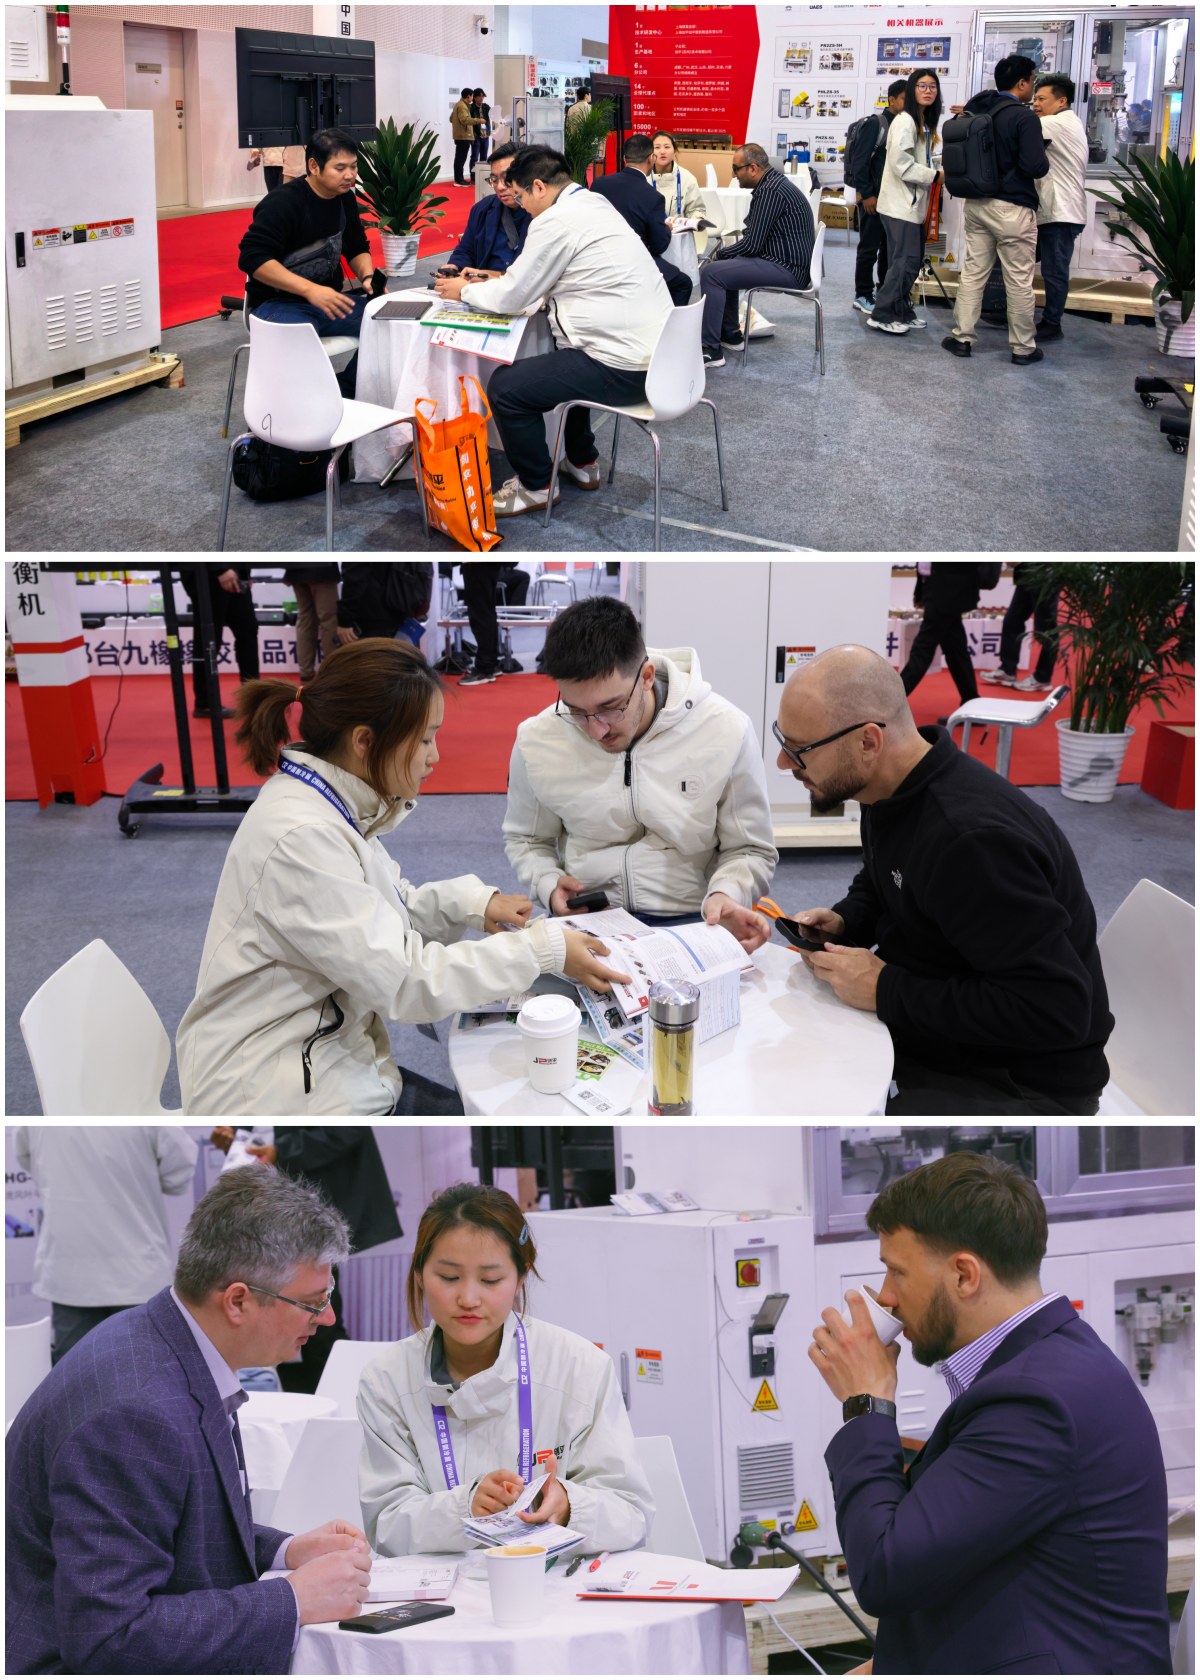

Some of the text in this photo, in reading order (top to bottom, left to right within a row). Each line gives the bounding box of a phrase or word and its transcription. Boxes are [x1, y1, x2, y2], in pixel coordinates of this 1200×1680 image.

[341, 5, 350, 36] 中国
[886, 18, 944, 27] 相关机器展示
[311, 777, 327, 791] CHINA
